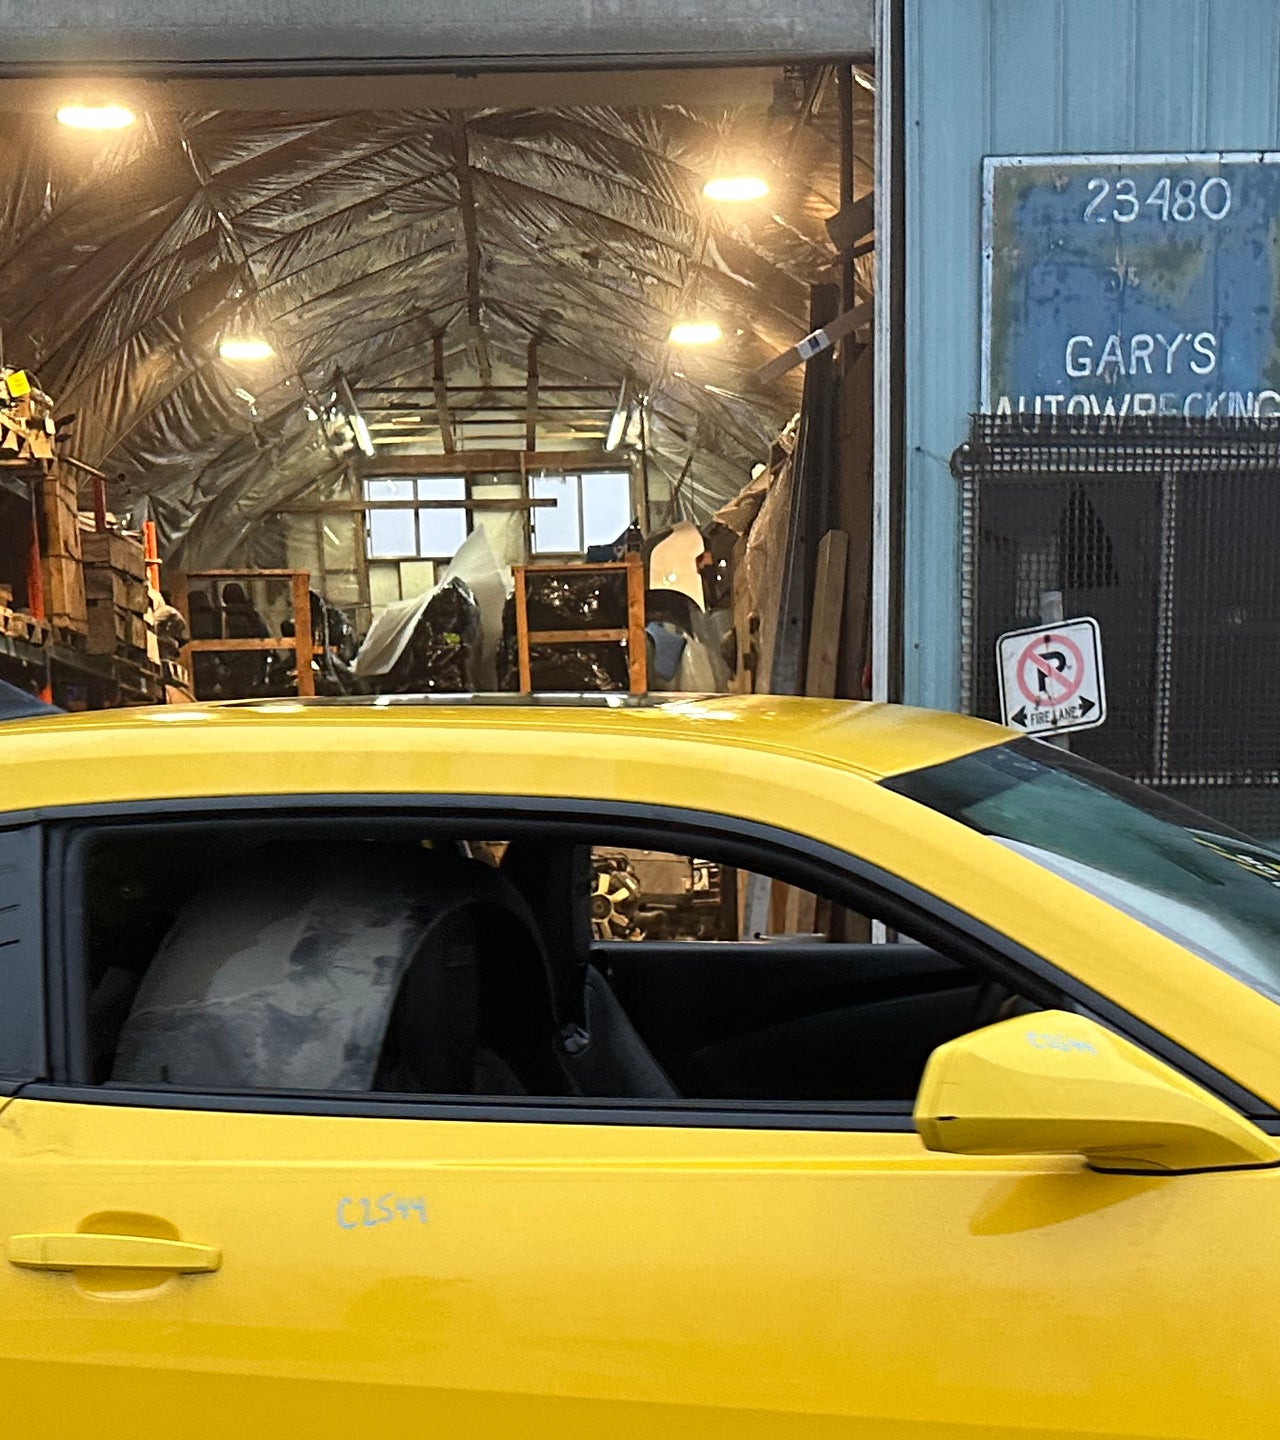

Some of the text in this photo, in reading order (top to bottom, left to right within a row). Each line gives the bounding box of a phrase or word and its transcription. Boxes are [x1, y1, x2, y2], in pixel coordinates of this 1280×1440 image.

[1083, 176, 1232, 223] 23480
[1065, 332, 1217, 377] GARY'S
[1030, 710, 1050, 726] FIRE
